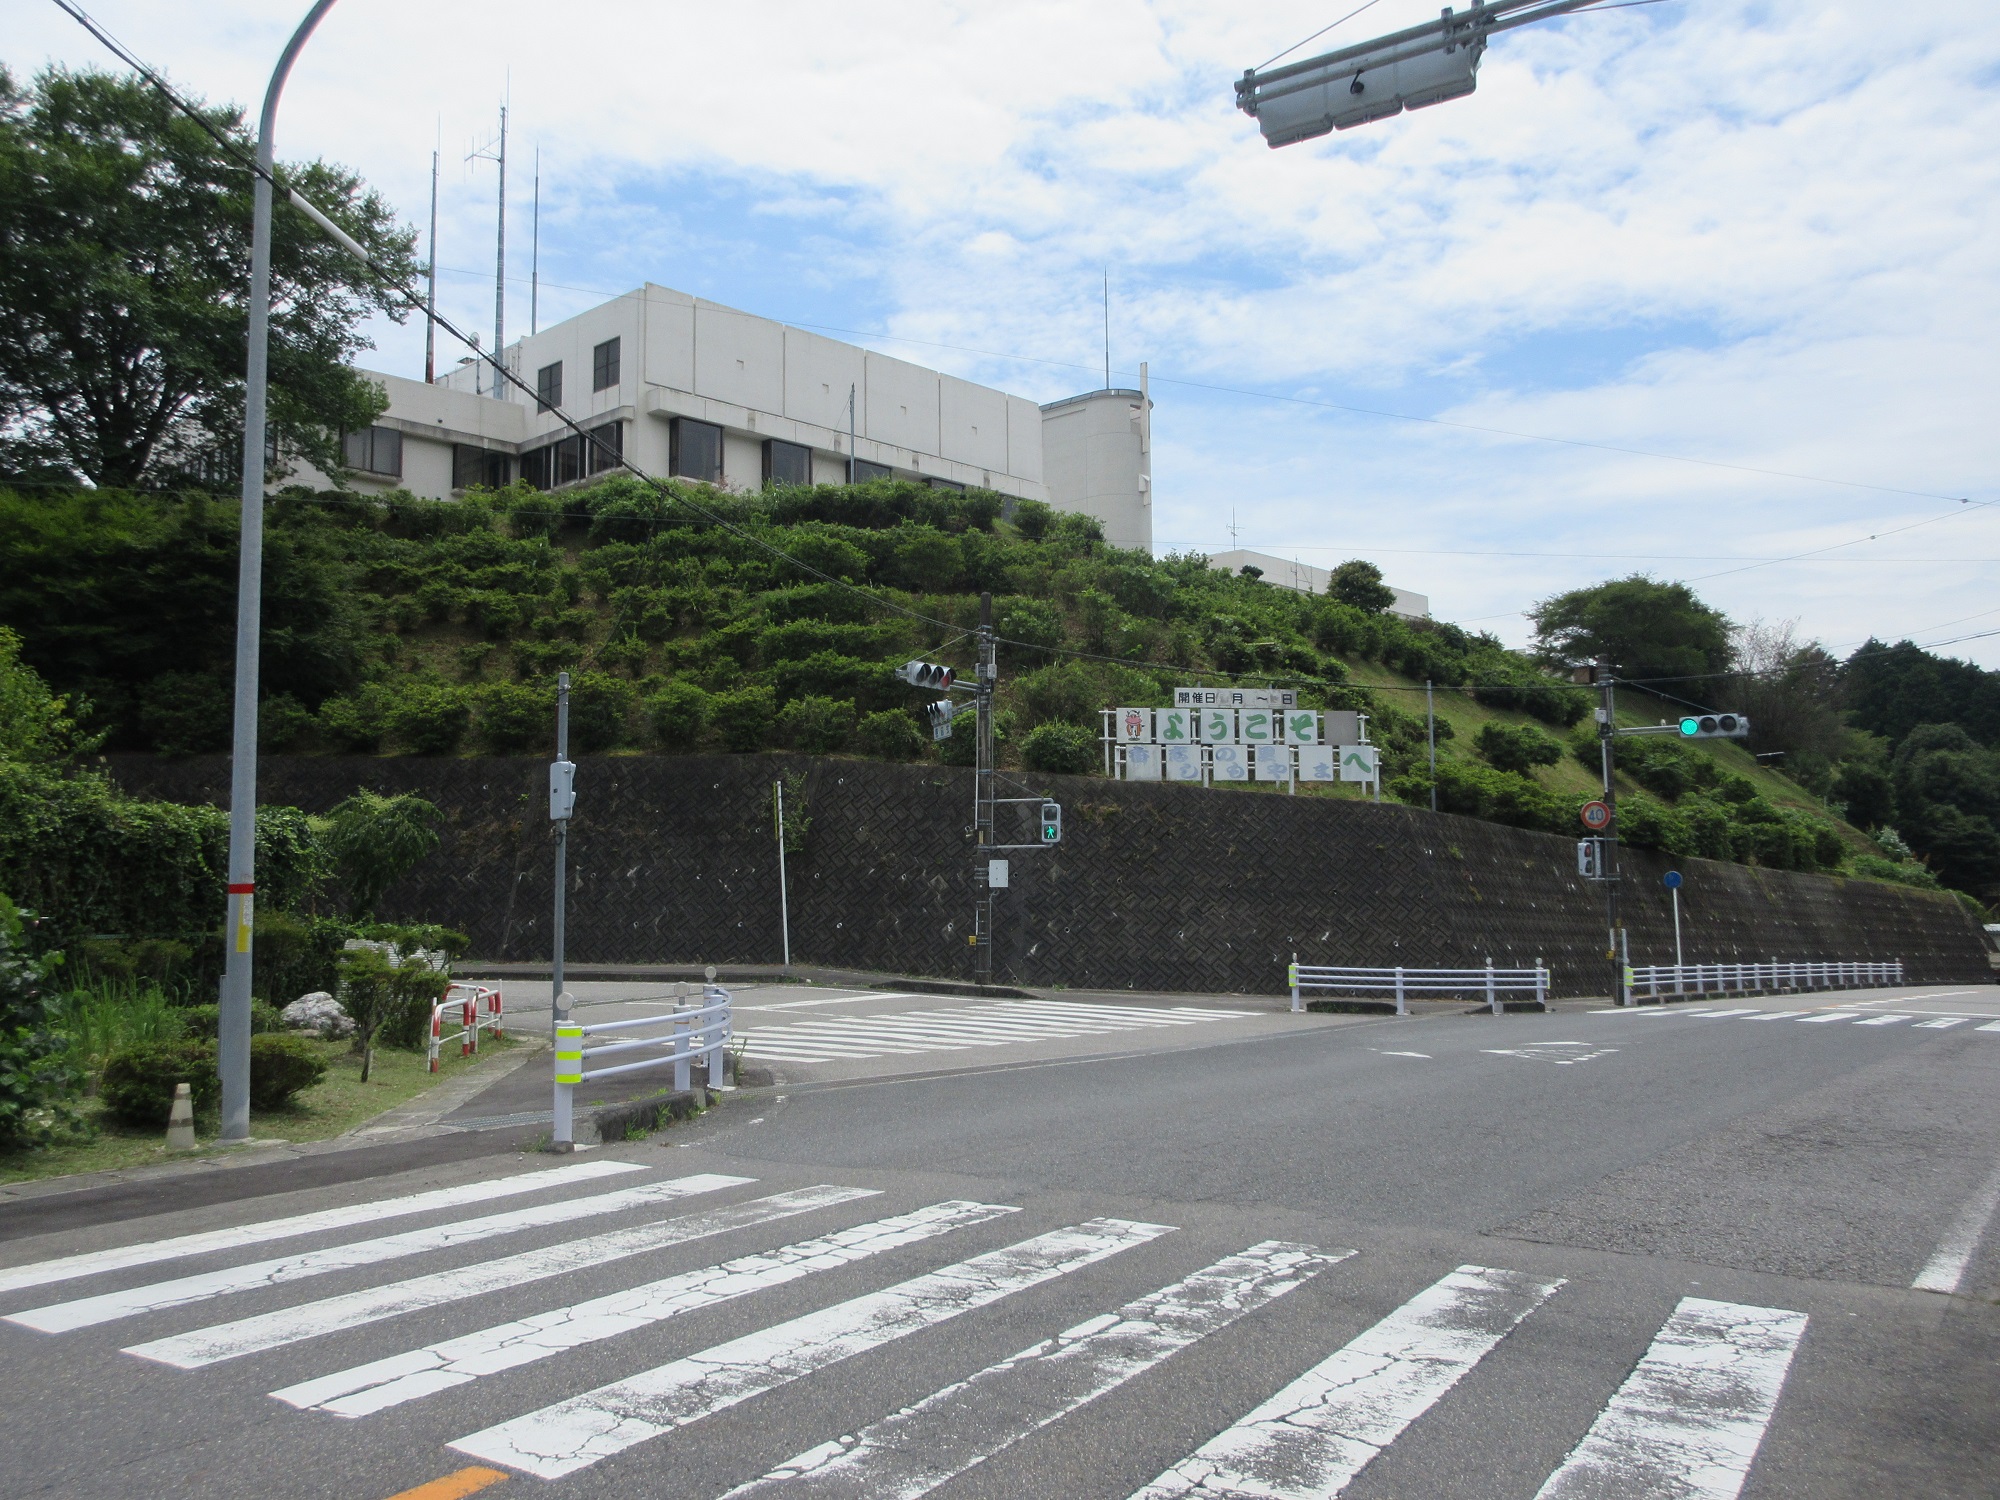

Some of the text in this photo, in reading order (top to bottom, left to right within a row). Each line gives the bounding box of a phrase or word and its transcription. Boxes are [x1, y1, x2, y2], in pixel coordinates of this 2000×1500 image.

[1178, 692, 1216, 704] 開催日
[1162, 712, 1315, 742] ようこそ
[1588, 809, 1604, 821] 40
